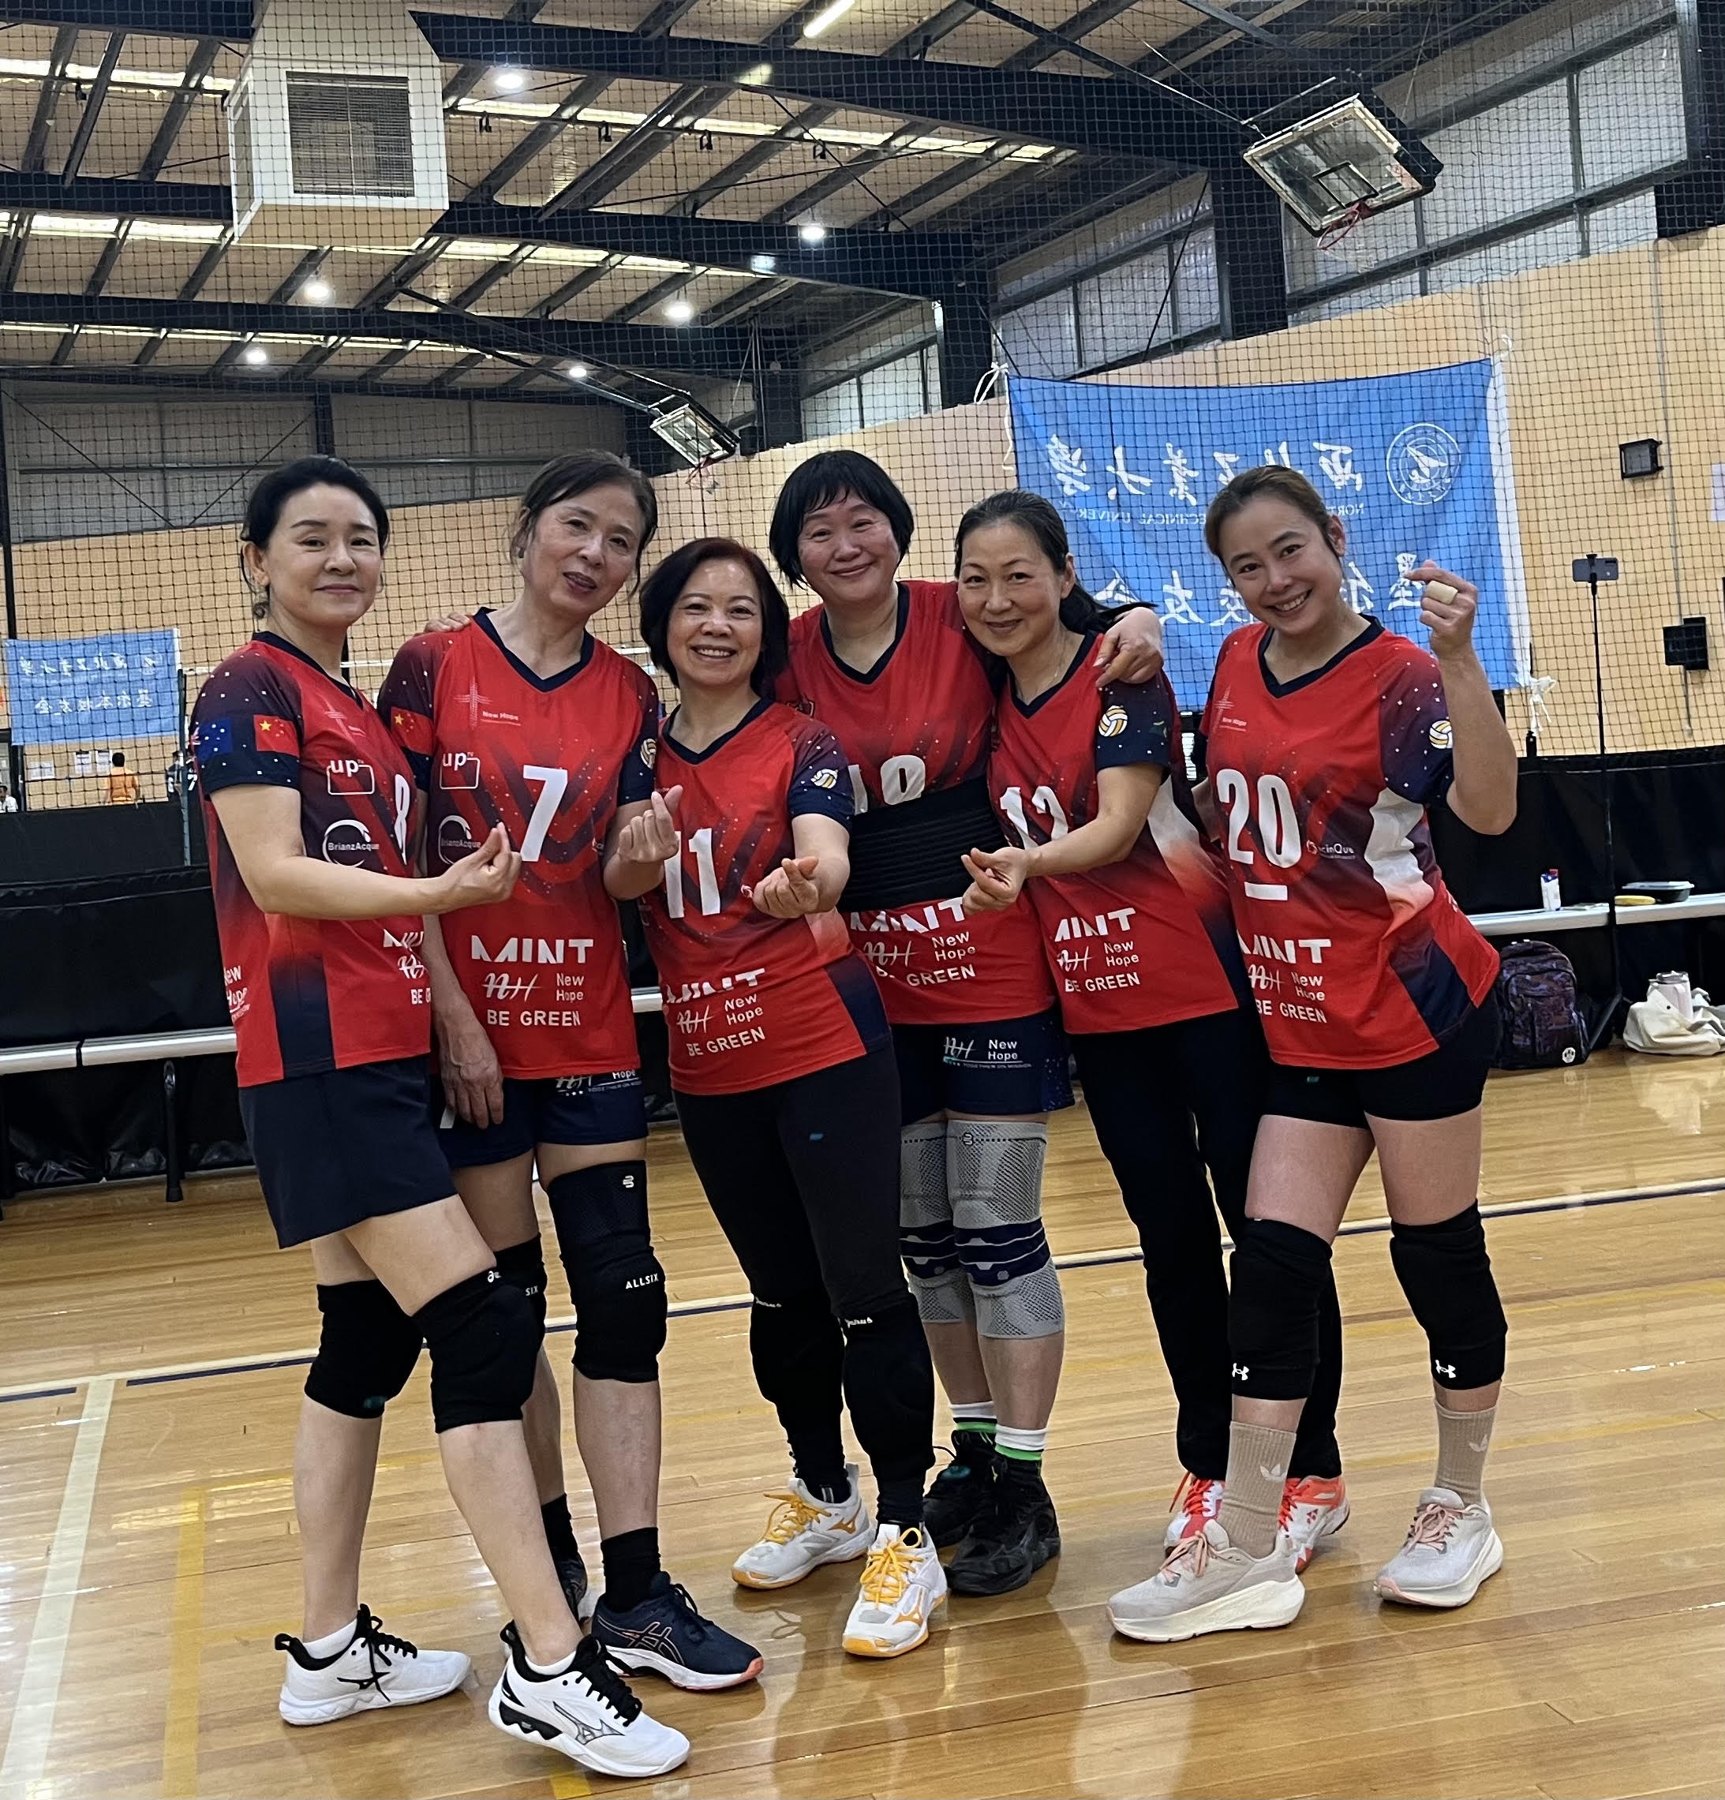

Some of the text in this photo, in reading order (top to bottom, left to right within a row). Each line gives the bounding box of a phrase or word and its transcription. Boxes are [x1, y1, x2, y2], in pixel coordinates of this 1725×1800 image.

[330, 759, 360, 778] up
[442, 752, 467, 771] up
[520, 764, 569, 862] 7
[1216, 768, 1302, 869] 20
[664, 827, 721, 919] 11
[931, 931, 970, 949] New
[1104, 940, 1134, 954] New
[471, 934, 594, 965] MINT
[934, 946, 976, 962] Hope
[1106, 954, 1139, 967] Hope
[556, 972, 584, 986] New
[906, 963, 976, 987] GREEN
[1065, 971, 1141, 993] BE GREEN
[1291, 971, 1324, 987] New
[411, 988, 423, 1005] BE
[556, 990, 584, 1002] Hope
[724, 993, 757, 1012] New
[487, 1009, 581, 1027] BE GREEN
[726, 1006, 764, 1026] Hope
[1255, 999, 1328, 1024] BE GREEN
[686, 1026, 766, 1057] BE GREEN
[988, 1039, 1018, 1050] New
[987, 1051, 1018, 1062] Hope
[625, 1273, 660, 1290] ALLSIX
[524, 1285, 539, 1297] SIX
